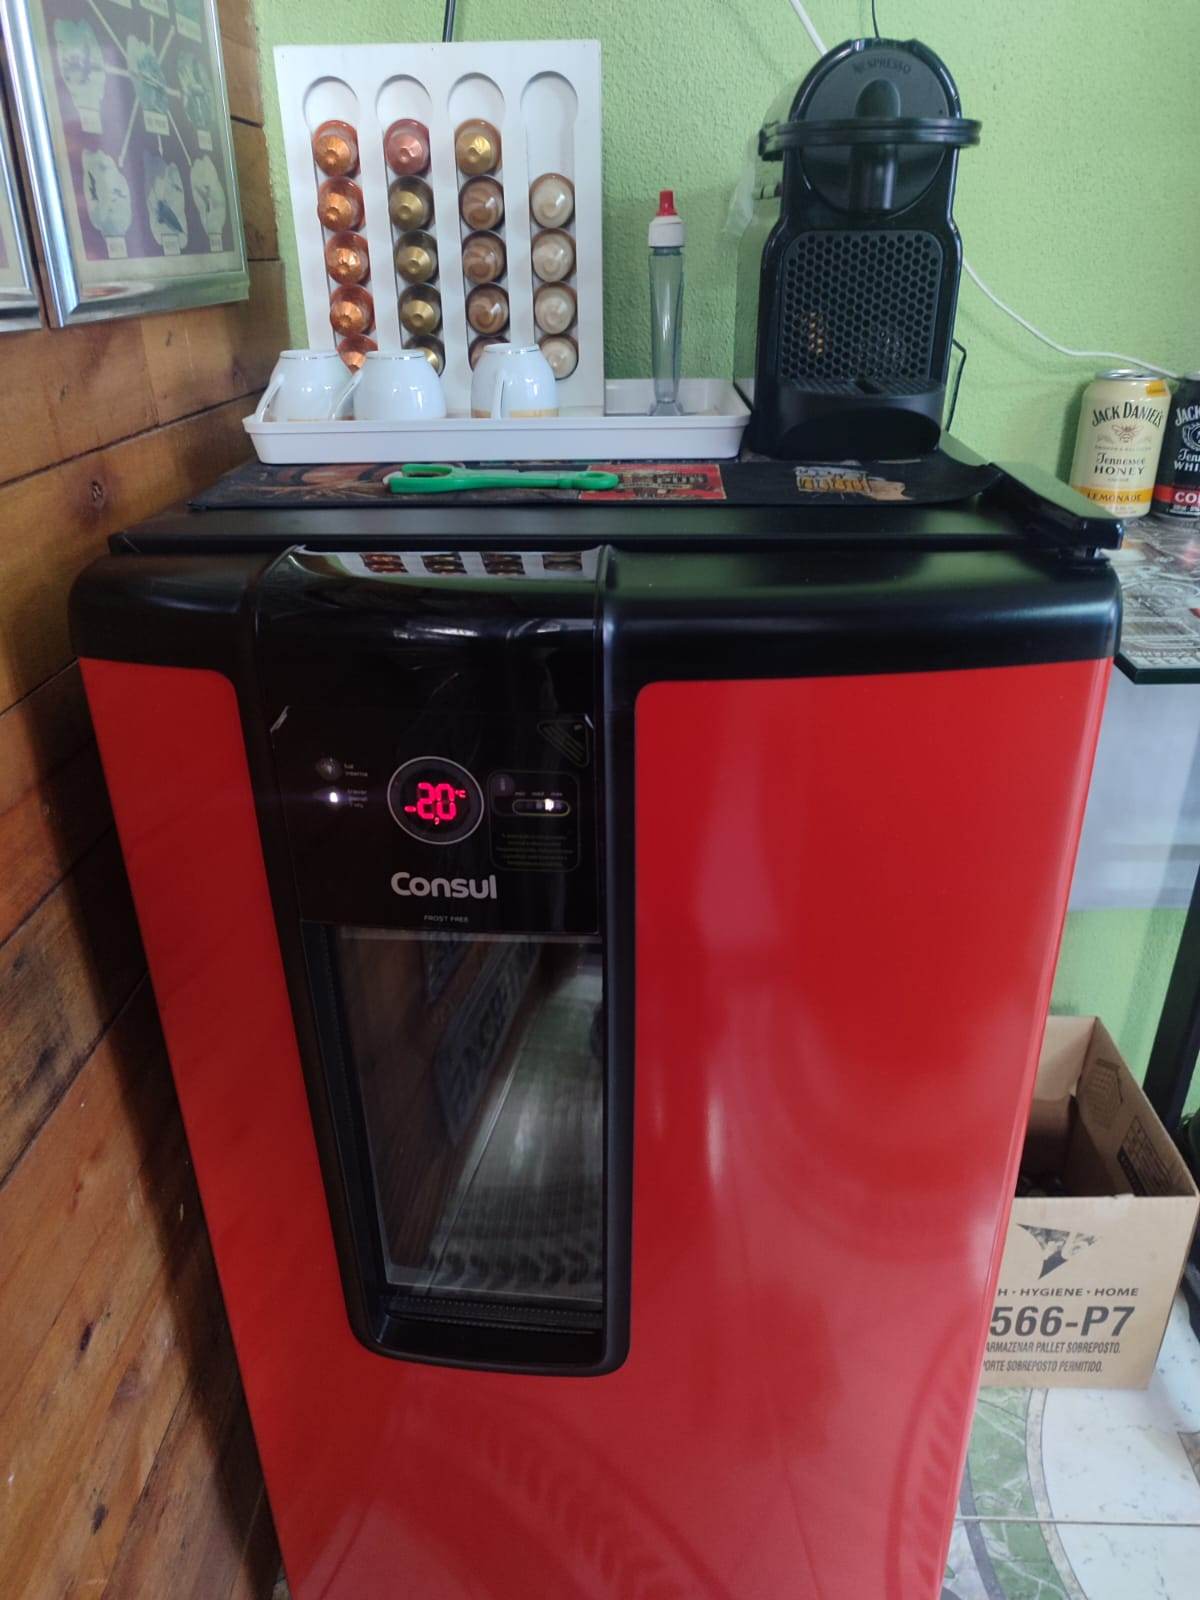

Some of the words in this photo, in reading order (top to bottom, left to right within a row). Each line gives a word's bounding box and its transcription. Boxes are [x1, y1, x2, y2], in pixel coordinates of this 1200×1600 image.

[1092, 406, 1120, 427] JACK
[1094, 465, 1145, 475] HONEY
[1087, 491, 1141, 502] LEMONADE
[391, 871, 497, 899] Consul
[424, 914, 448, 922] FROST
[450, 915, 469, 923] FREE
[1020, 1288, 1083, 1297] HYGIENE
[1094, 1288, 1139, 1297] HOME
[989, 1306, 1136, 1337] 566-P7
[1036, 1341, 1066, 1353] PALLET
[1007, 1360, 1058, 1372] SOBREPOSTO
